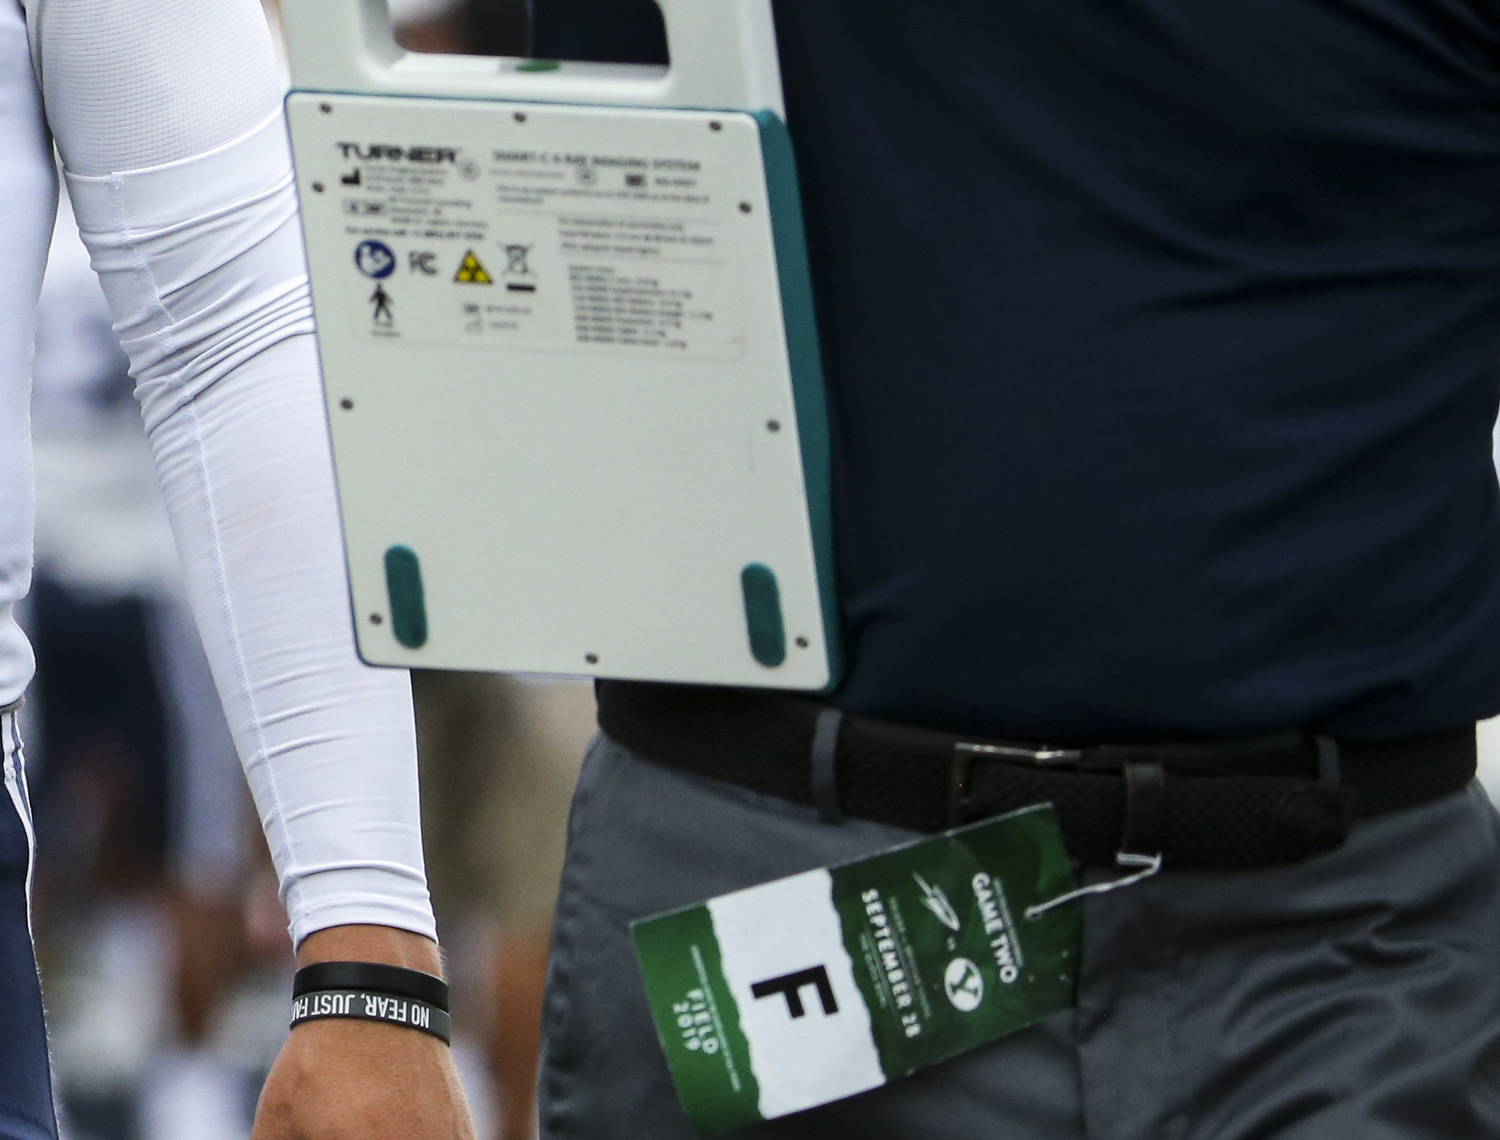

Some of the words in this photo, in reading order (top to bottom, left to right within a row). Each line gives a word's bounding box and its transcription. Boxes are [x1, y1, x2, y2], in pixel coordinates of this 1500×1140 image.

[336, 141, 457, 163] TURNER
[971, 872, 1005, 935] GAME
[990, 933, 1018, 984] TWO
[861, 888, 913, 1010] SEPTEMBER
[901, 1012, 922, 1039] 28
[311, 994, 356, 1016] JUST
[360, 993, 407, 1023] FEAR,
[411, 1003, 430, 1029] NO
[750, 965, 839, 1020] F
[672, 1000, 702, 1051] 2019
[686, 988, 719, 1055] FIELD
